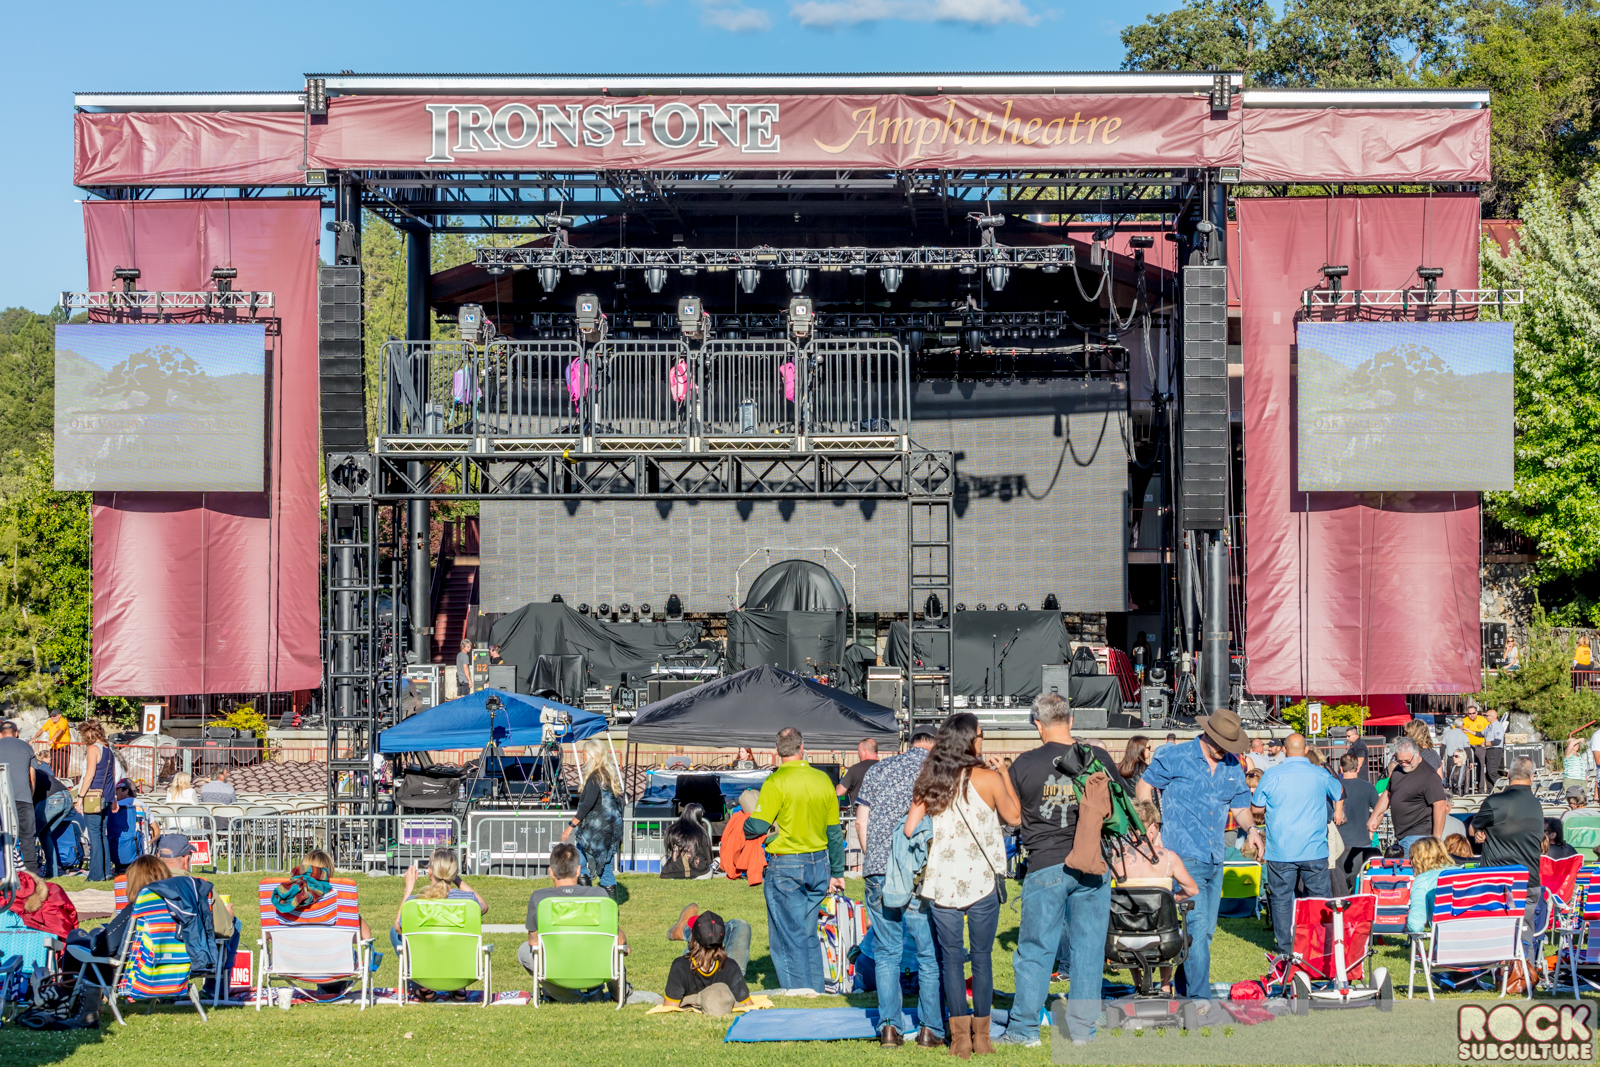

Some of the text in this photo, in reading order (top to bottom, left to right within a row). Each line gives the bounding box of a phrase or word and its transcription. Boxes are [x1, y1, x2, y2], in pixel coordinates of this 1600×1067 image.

[425, 99, 1122, 163] IRONSTONE Amphitheatre
[146, 713, 156, 732] B
[1311, 712, 1319, 732] B
